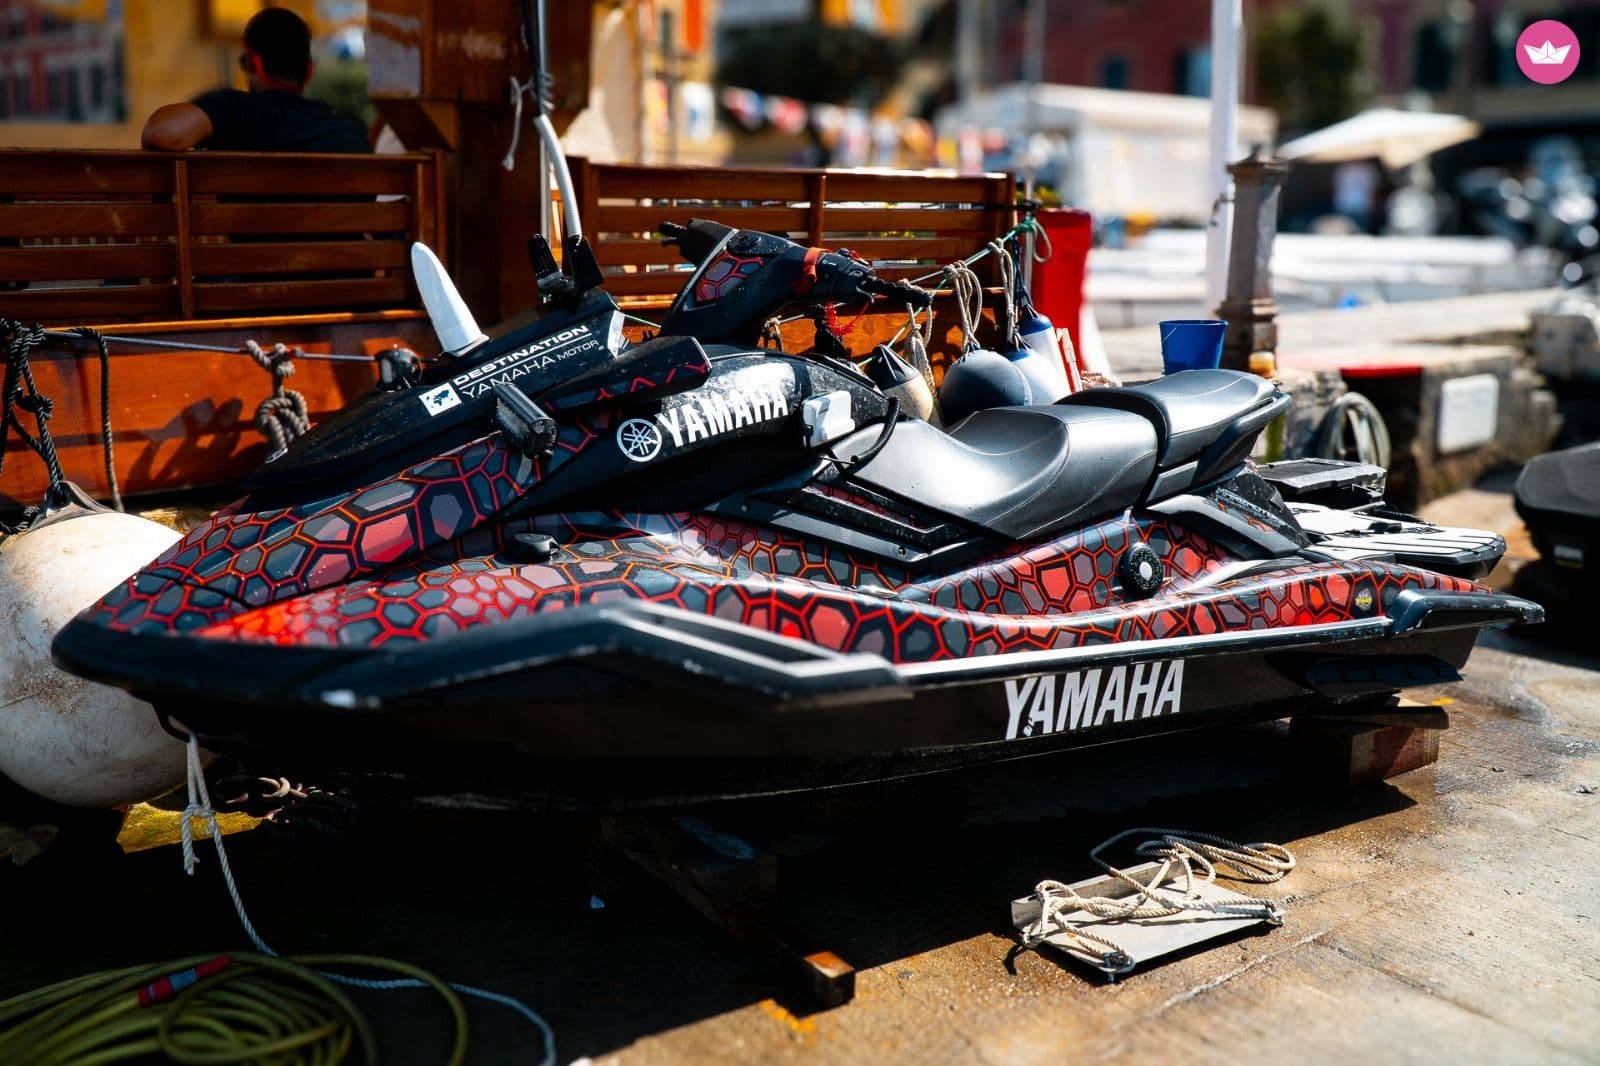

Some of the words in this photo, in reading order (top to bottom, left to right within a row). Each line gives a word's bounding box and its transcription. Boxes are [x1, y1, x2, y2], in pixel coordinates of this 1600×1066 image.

[453, 324, 589, 386] DESTINATION
[462, 355, 556, 399] YAMAHA
[556, 339, 600, 361] MOTOR
[654, 388, 788, 448] YAMAHA
[1004, 659, 1185, 740] YAMAHA
